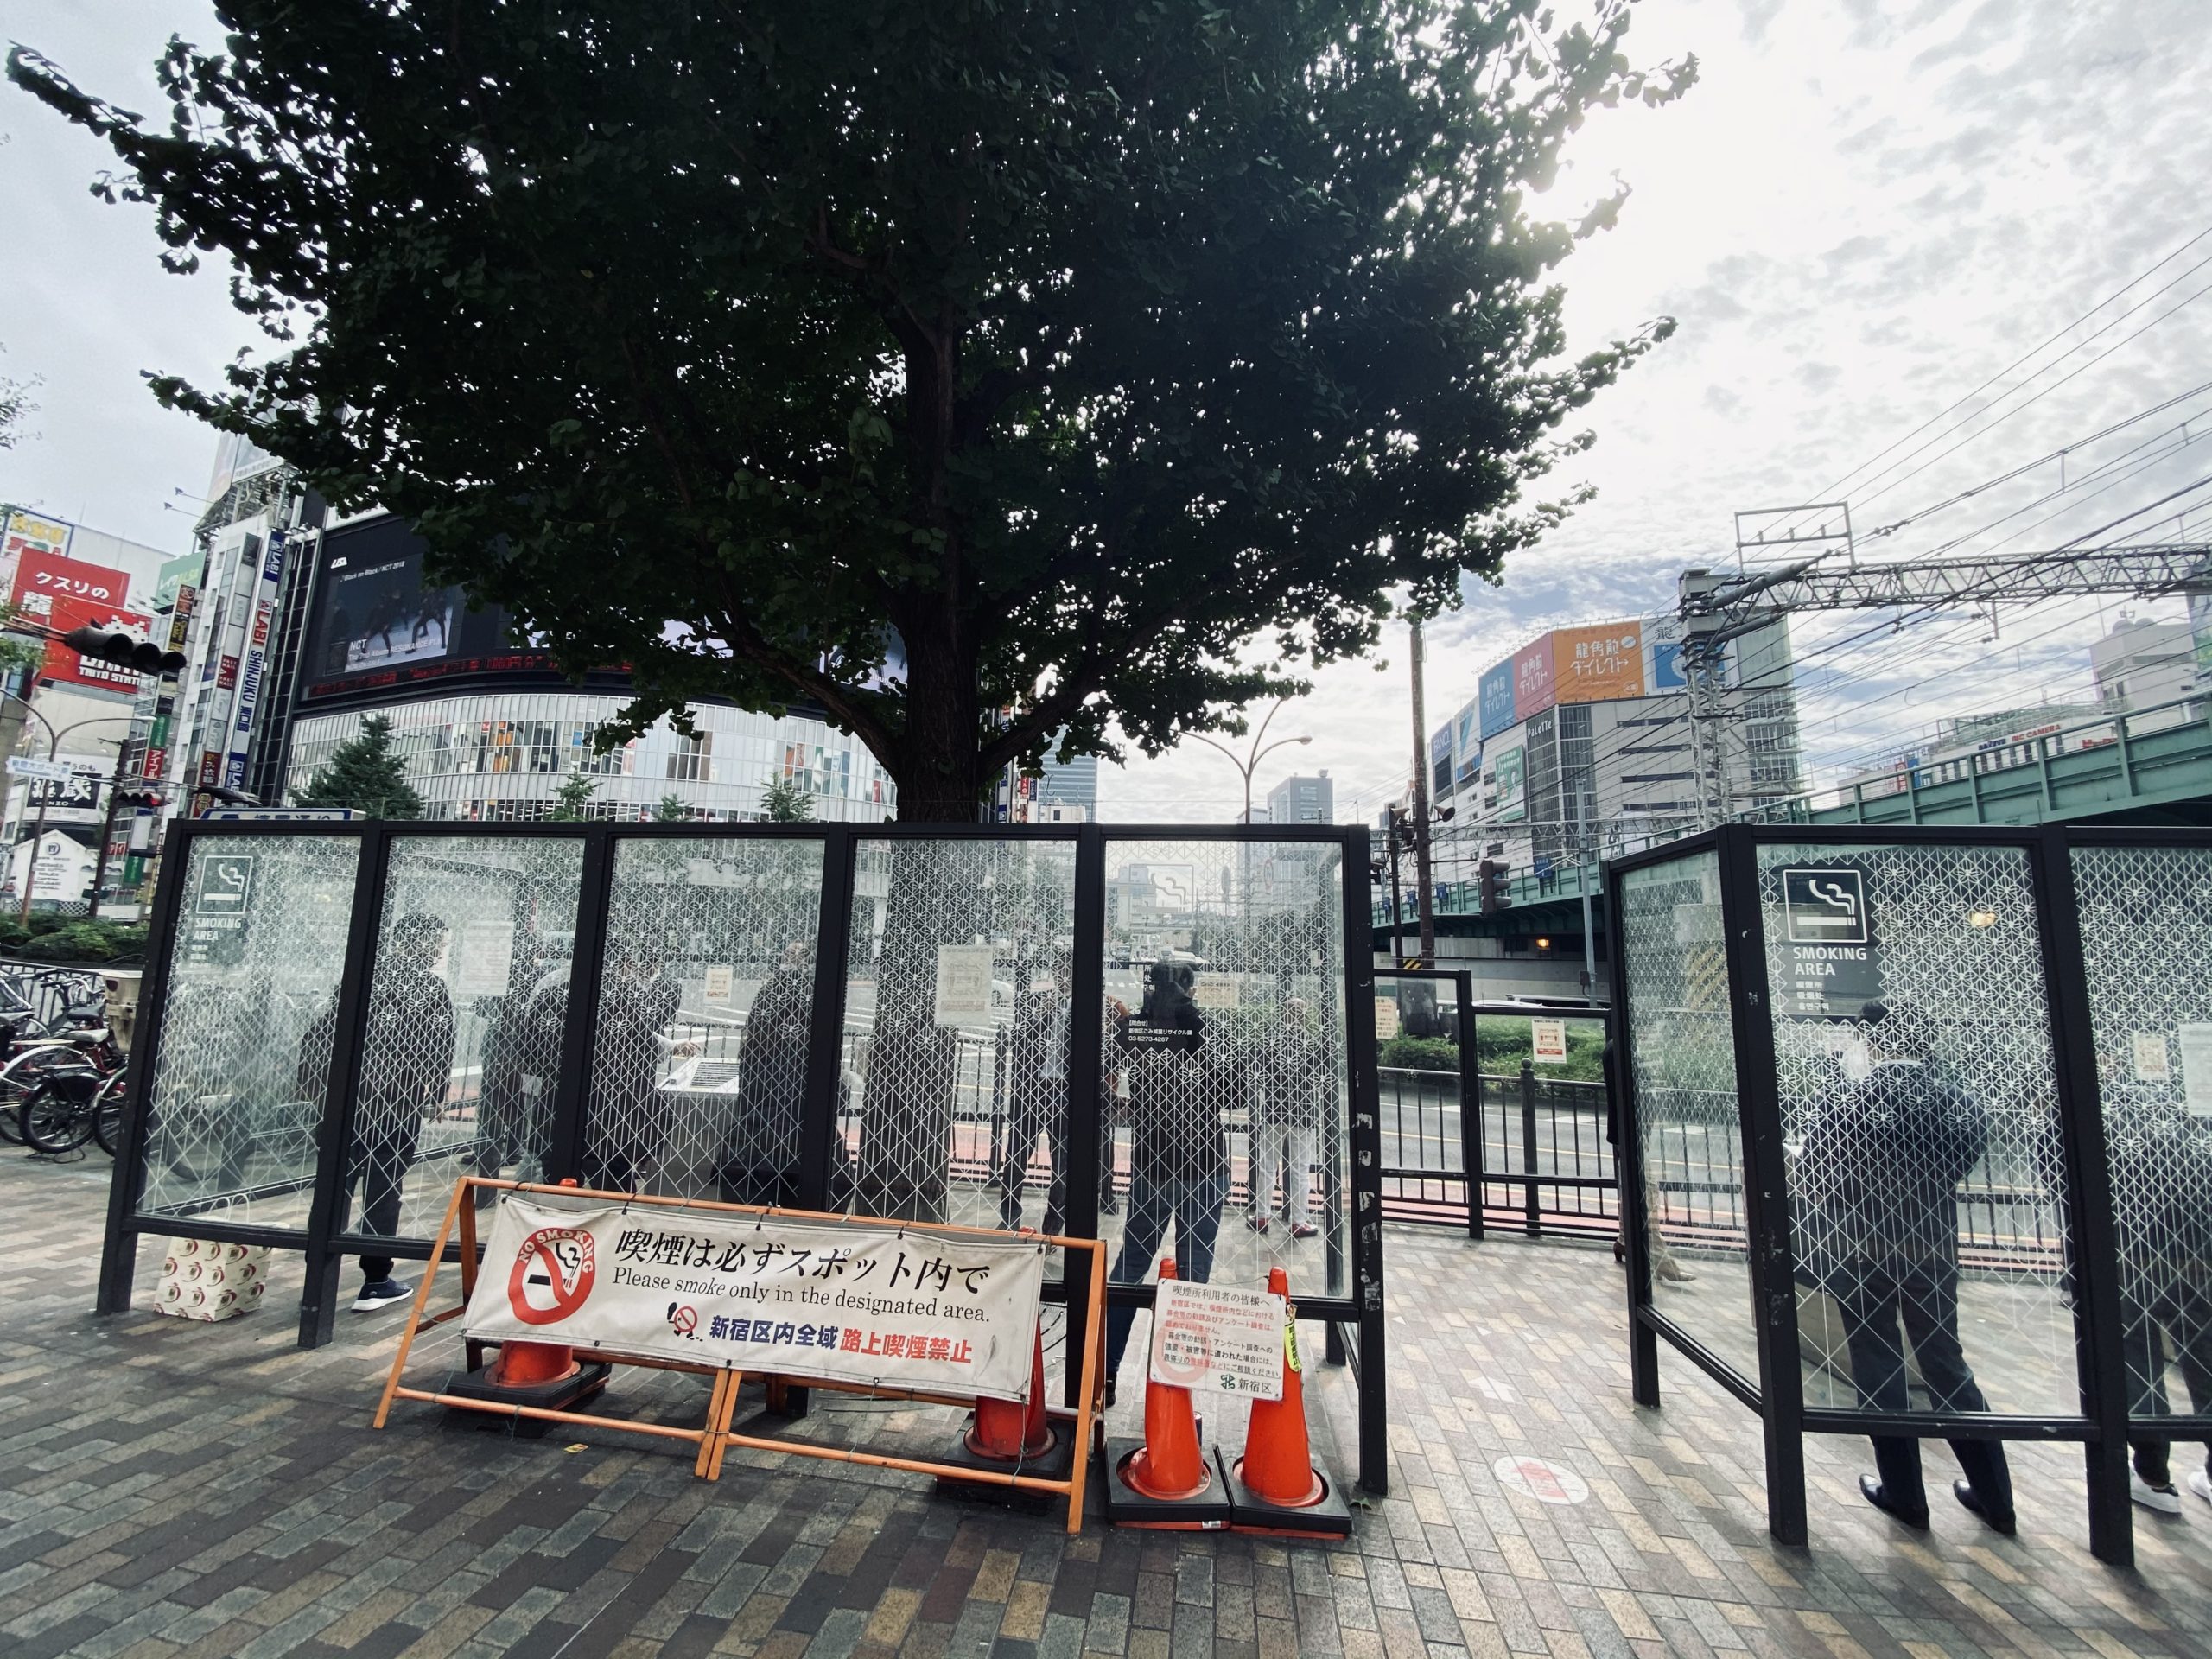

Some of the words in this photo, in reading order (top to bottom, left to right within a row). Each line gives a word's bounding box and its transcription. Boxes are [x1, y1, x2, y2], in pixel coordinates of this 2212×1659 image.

[270, 552, 282, 575] LABI
[35, 571, 109, 599] クスリの
[252, 610, 270, 646] LABI
[350, 639, 367, 651] NCT
[79, 666, 109, 680] TAITO
[243, 650, 263, 702] SHINJUKU
[1570, 657, 1629, 677] ダイレクト
[2026, 724, 2061, 737] CAMERA
[195, 918, 242, 928] SMOKING
[193, 930, 219, 941] AREA
[1793, 946, 1867, 960] SMOKING
[1795, 962, 1836, 976] AREA
[518, 1241, 535, 1263] NO
[536, 1230, 594, 1273] SMOKING
[615, 1229, 990, 1294] 喫煙は必ずスポット内で
[613, 1267, 670, 1290] Please
[675, 1277, 726, 1295] smoke
[729, 1282, 770, 1303] only
[775, 1285, 793, 1302] in
[801, 1286, 830, 1305] the
[836, 1289, 937, 1316] designated
[944, 1305, 989, 1322] area.
[1173, 1285, 1270, 1306] 喫煙所利用者の皆様へ
[709, 1315, 838, 1350] 新宿区内全域
[840, 1328, 972, 1363] 路上喫煙禁止
[1238, 1378, 1272, 1395] 新宿区
